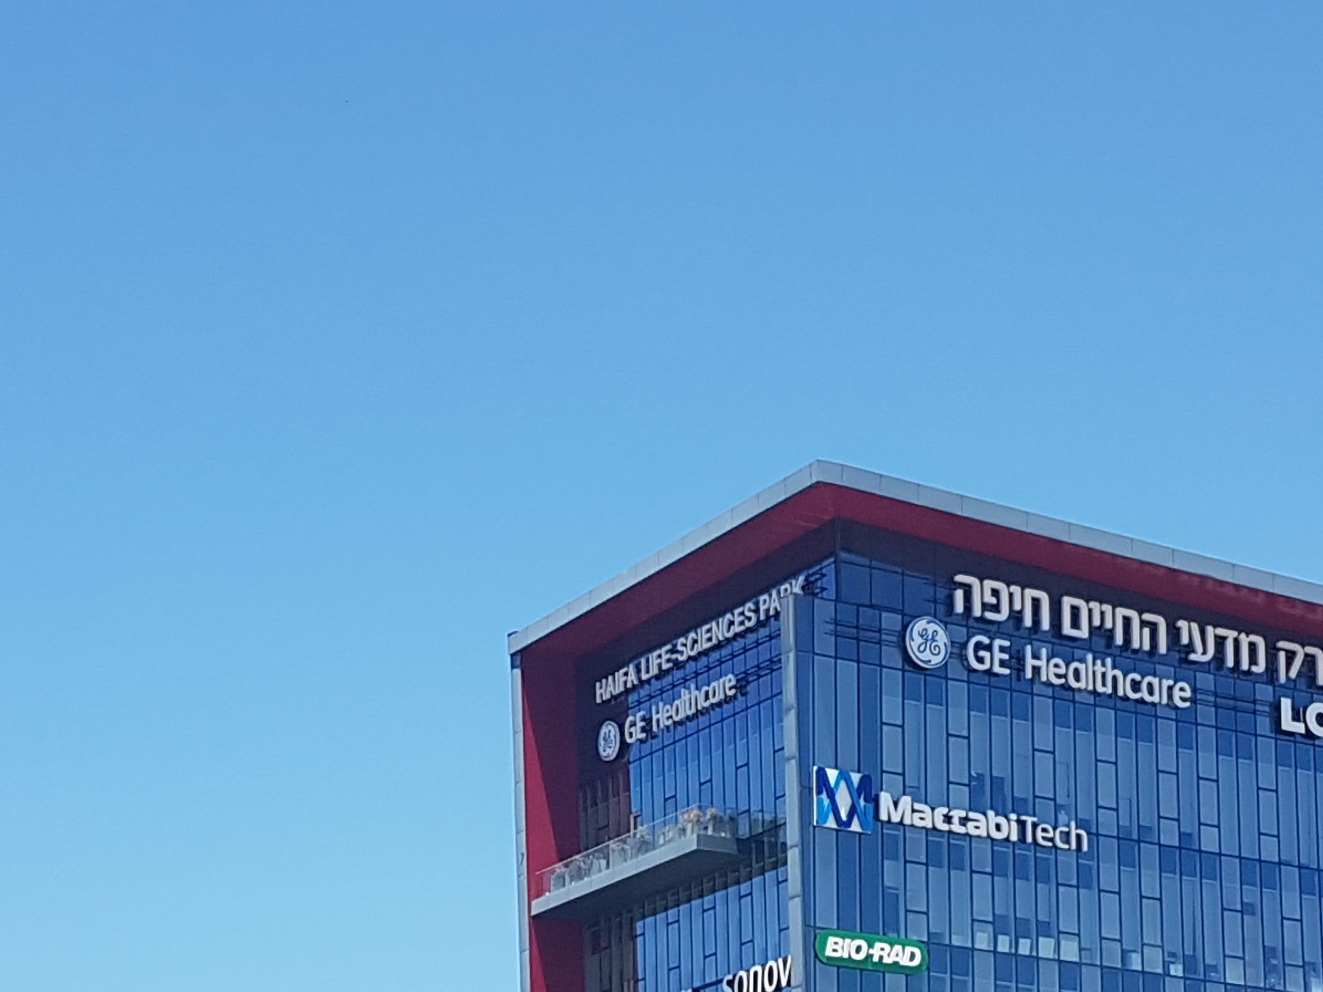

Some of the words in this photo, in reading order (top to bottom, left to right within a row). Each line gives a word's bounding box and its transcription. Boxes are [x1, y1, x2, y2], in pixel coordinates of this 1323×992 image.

[953, 574, 1050, 631] חיפה
[1060, 596, 1168, 655] החיים
[595, 662, 639, 704] HAIFA
[641, 602, 757, 682] LIFE-SCIENCES
[966, 635, 1011, 675] GE
[1024, 645, 1192, 708] Healthcare
[1174, 617, 1266, 674] מדעי
[624, 711, 647, 744] GE
[652, 673, 737, 732] Healthcare
[879, 791, 1089, 852] MaccabiTech
[825, 936, 921, 967] BIO-RAD
